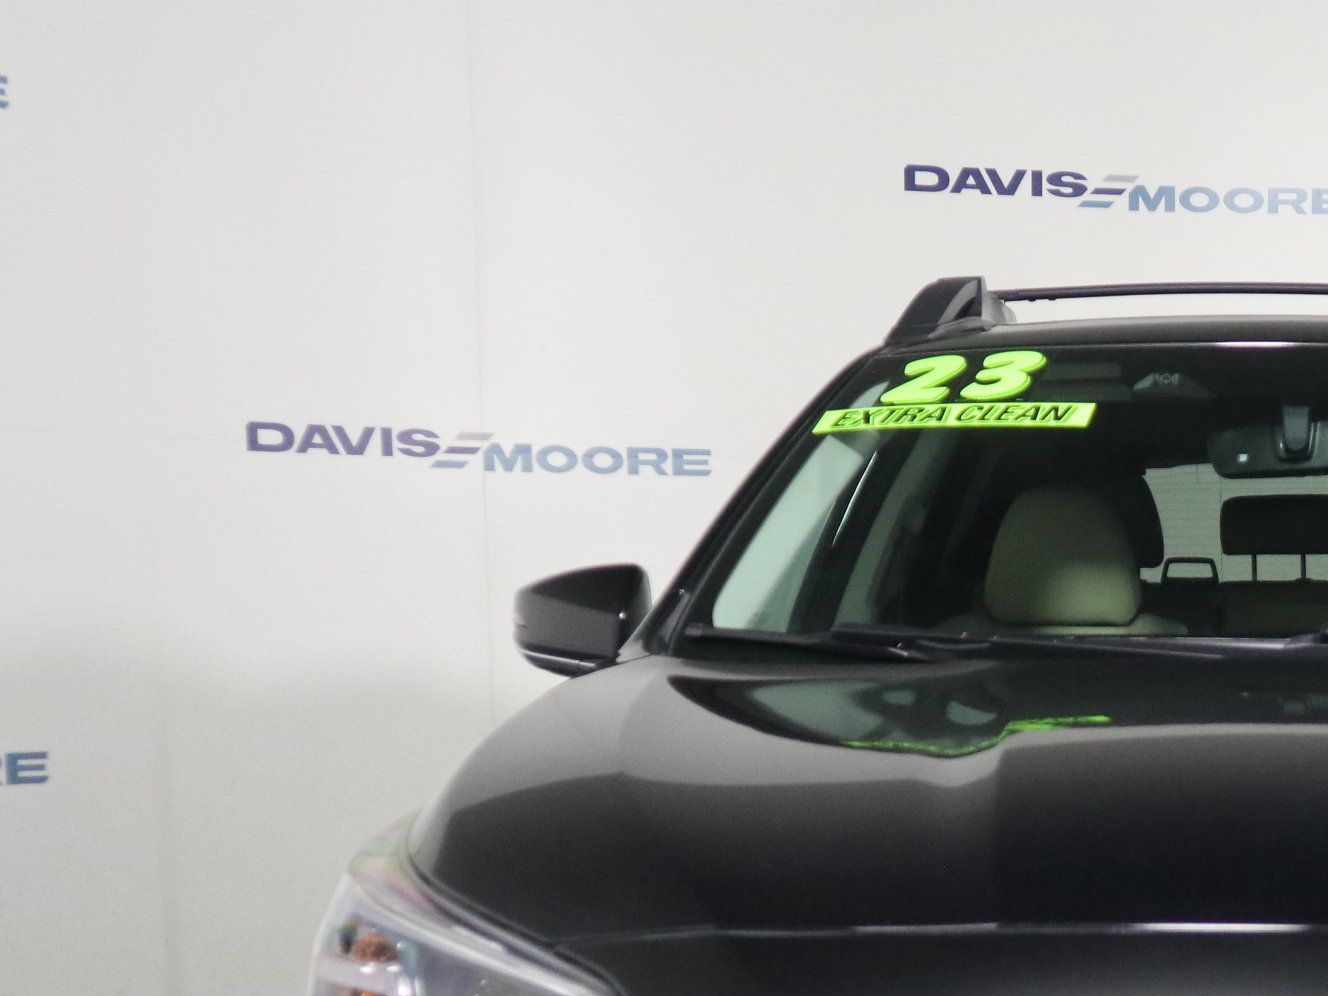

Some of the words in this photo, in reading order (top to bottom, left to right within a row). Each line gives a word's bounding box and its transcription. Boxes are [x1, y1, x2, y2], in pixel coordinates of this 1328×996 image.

[904, 163, 1089, 198] DAVIS
[880, 350, 1047, 404] 23
[831, 405, 948, 428] EXTRA
[954, 405, 1077, 426] CLEAN
[246, 420, 441, 458] DAVIS
[482, 442, 713, 477] MOORE
